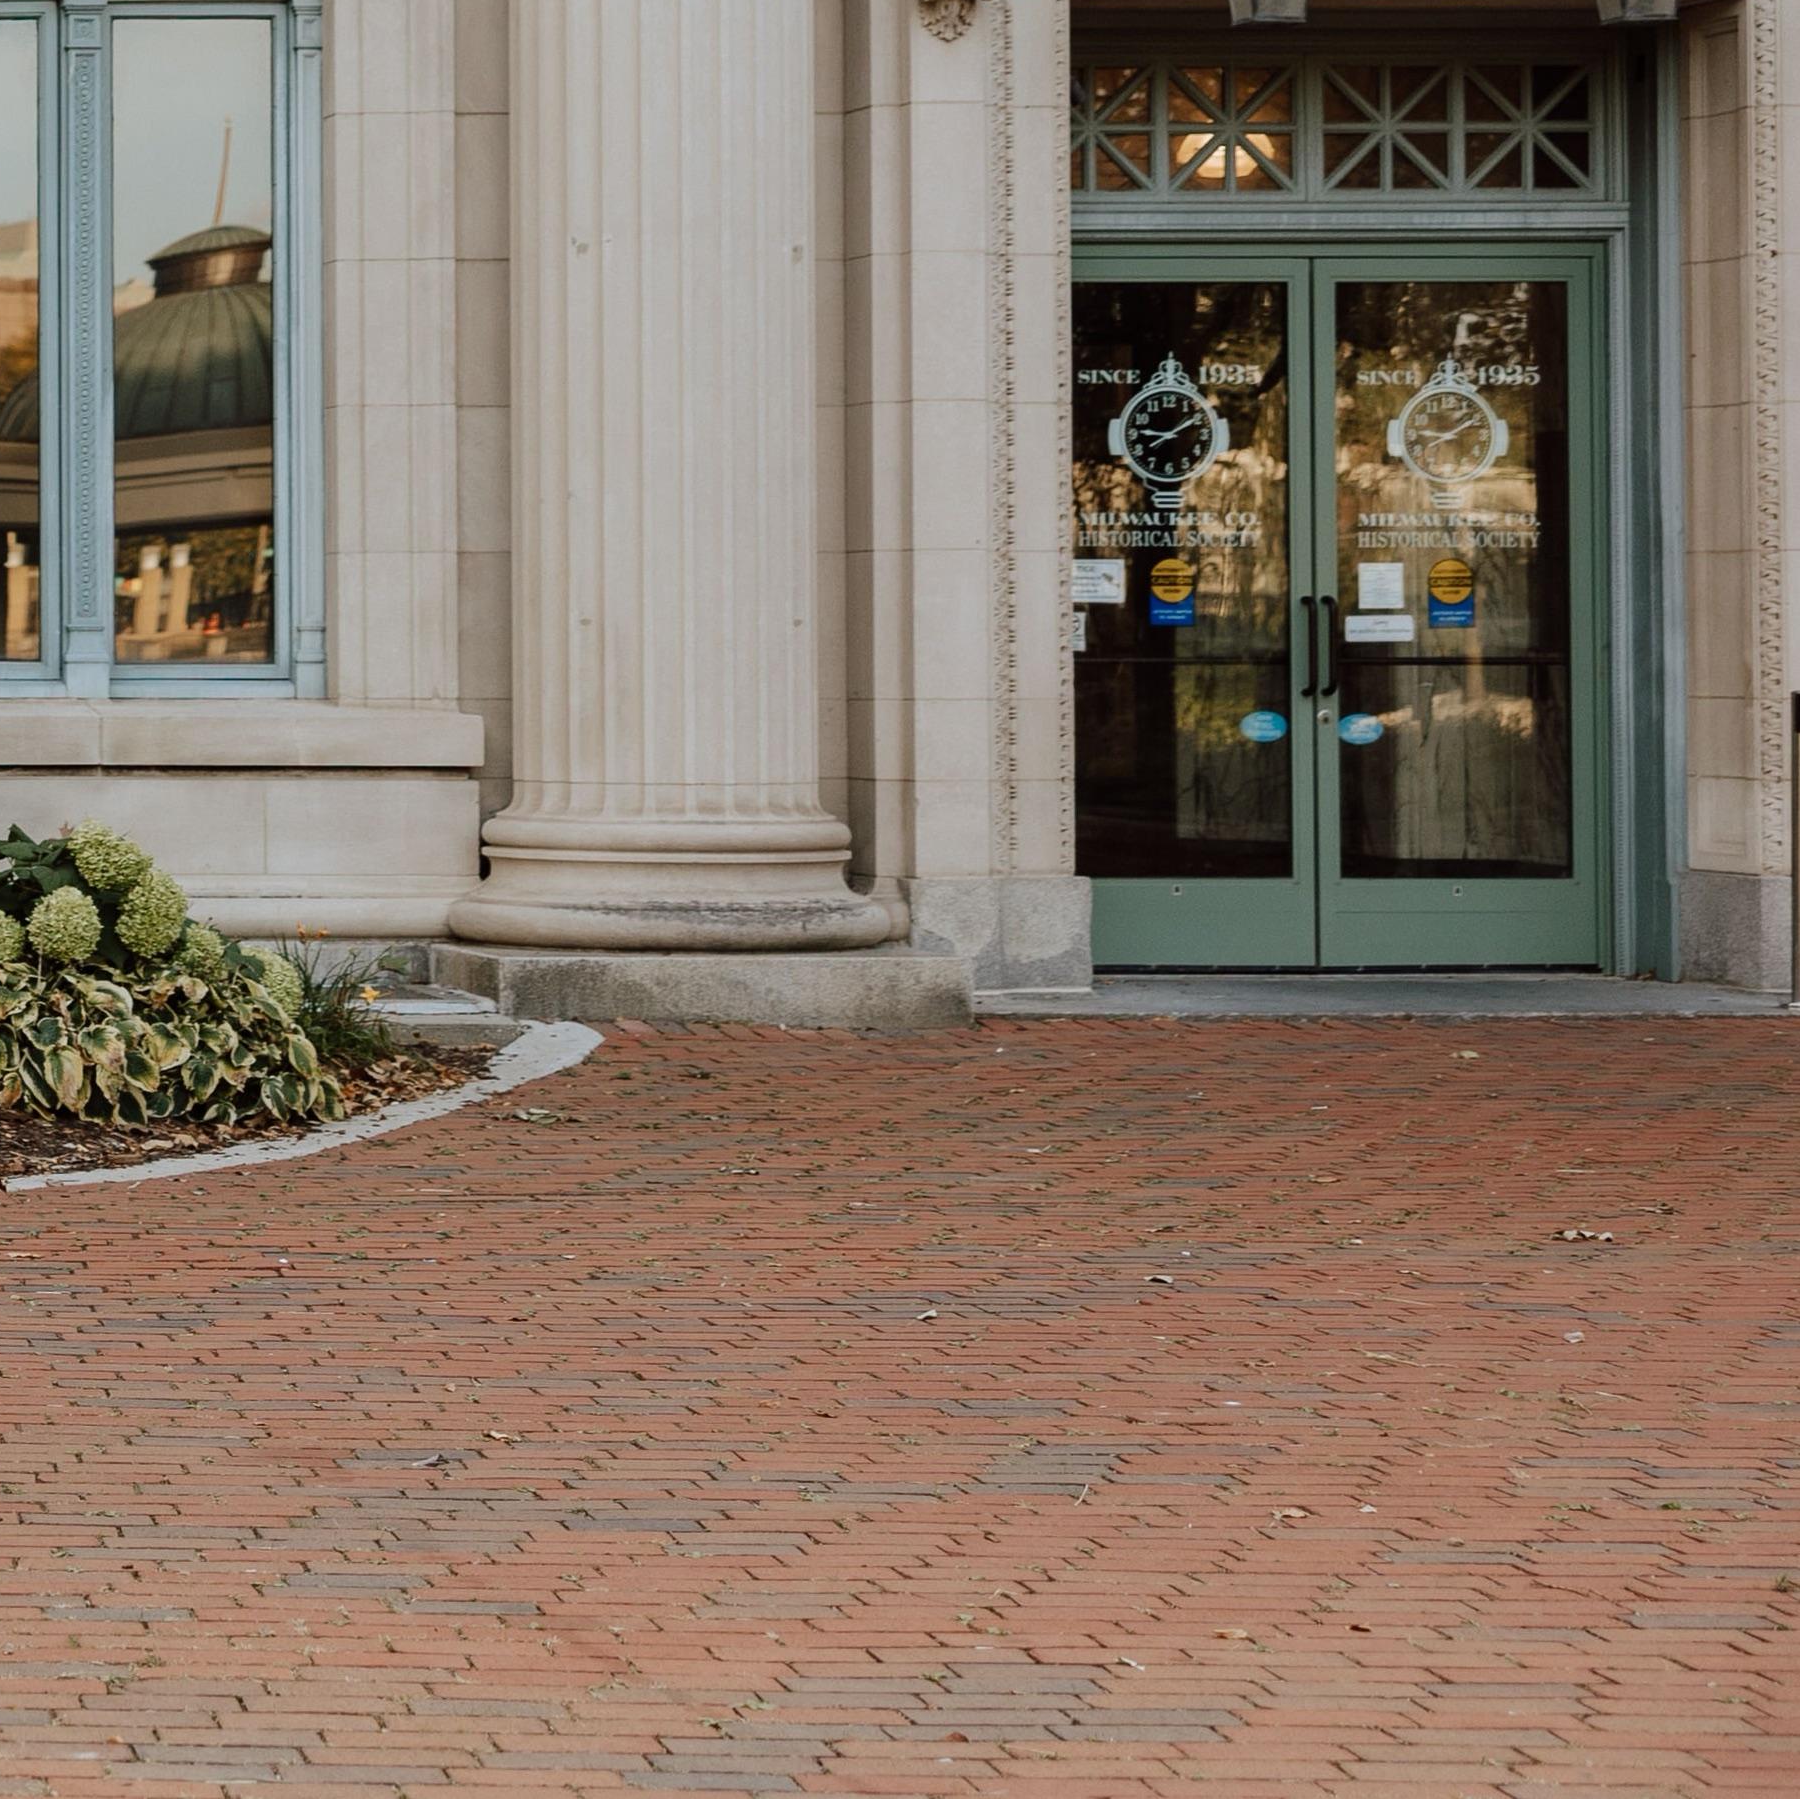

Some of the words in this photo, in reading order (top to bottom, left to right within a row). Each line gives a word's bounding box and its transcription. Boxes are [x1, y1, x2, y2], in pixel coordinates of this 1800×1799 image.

[1077, 369, 1141, 385] SINCE
[1199, 364, 1262, 386] 1935
[1356, 370, 1419, 386] SINCE
[1478, 365, 1541, 386] 1935
[1147, 400, 1160, 413] 11
[1162, 396, 1177, 408] 12
[1182, 401, 1189, 413] 1
[1135, 413, 1150, 426] 10
[1128, 428, 1139, 441] 9
[1200, 428, 1210, 441] 3
[1192, 444, 1202, 457] 4
[1147, 457, 1157, 470] 7
[1164, 462, 1174, 475] 6
[1181, 457, 1191, 470] 5
[1078, 511, 1219, 527] MILWAUKEE
[1224, 511, 1262, 527] CO.
[1357, 512, 1499, 528] MILWAUKEE
[1504, 512, 1542, 528] CO.
[1078, 530, 1185, 548] HISTORICAL
[1187, 530, 1263, 548] SOCIETY
[1357, 531, 1460, 549] HISTORICAL
[1465, 531, 1541, 549] SOCIETY
